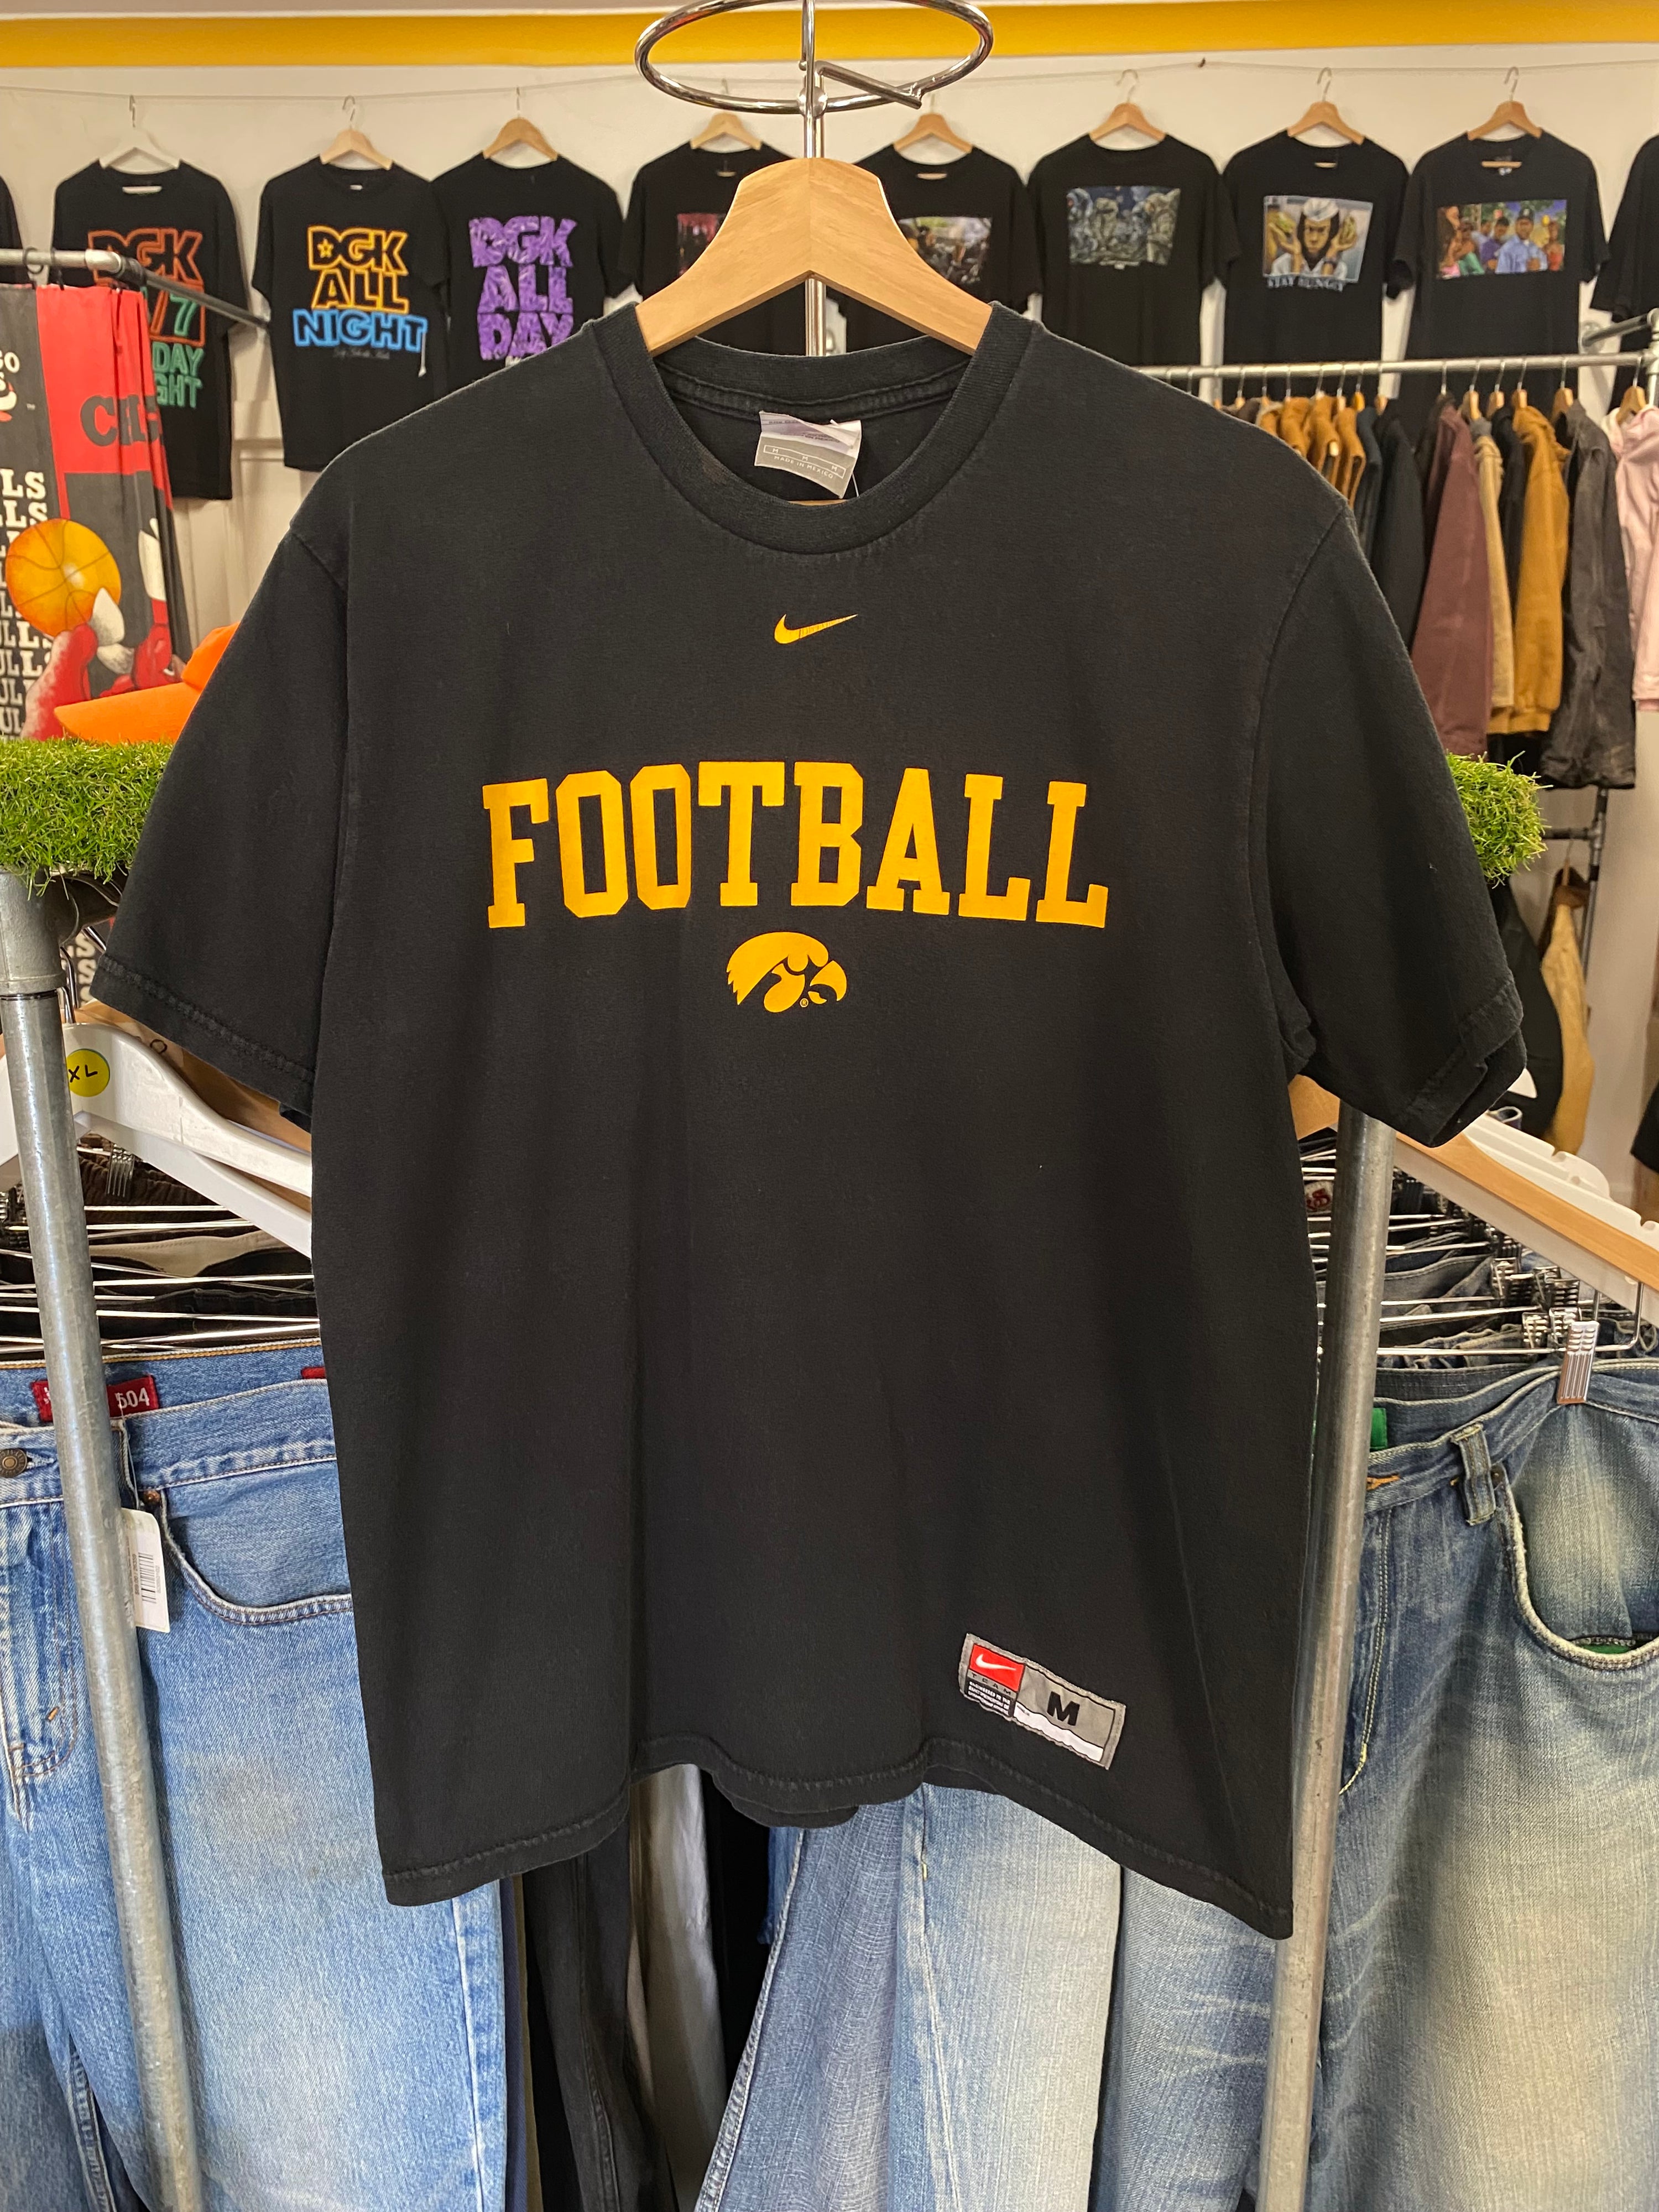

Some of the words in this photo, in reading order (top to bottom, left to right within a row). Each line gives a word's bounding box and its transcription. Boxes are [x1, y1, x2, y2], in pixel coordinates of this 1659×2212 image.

[307, 225, 409, 276] DGK
[468, 215, 578, 268] DGK
[311, 268, 410, 315] ALL
[477, 264, 573, 314] ALL
[292, 308, 428, 353] NIGHT
[477, 312, 573, 360] DAY
[152, 341, 205, 377] DAY
[155, 373, 202, 408] GHT
[774, 455, 794, 465] MADE
[807, 464, 833, 479] MEXICO
[482, 760, 1109, 928] FOOTBALL
[69, 1065, 97, 1082] XL
[114, 1387, 150, 1410] 504
[972, 1672, 1011, 1695] TEAM
[1047, 1691, 1081, 1726] M
